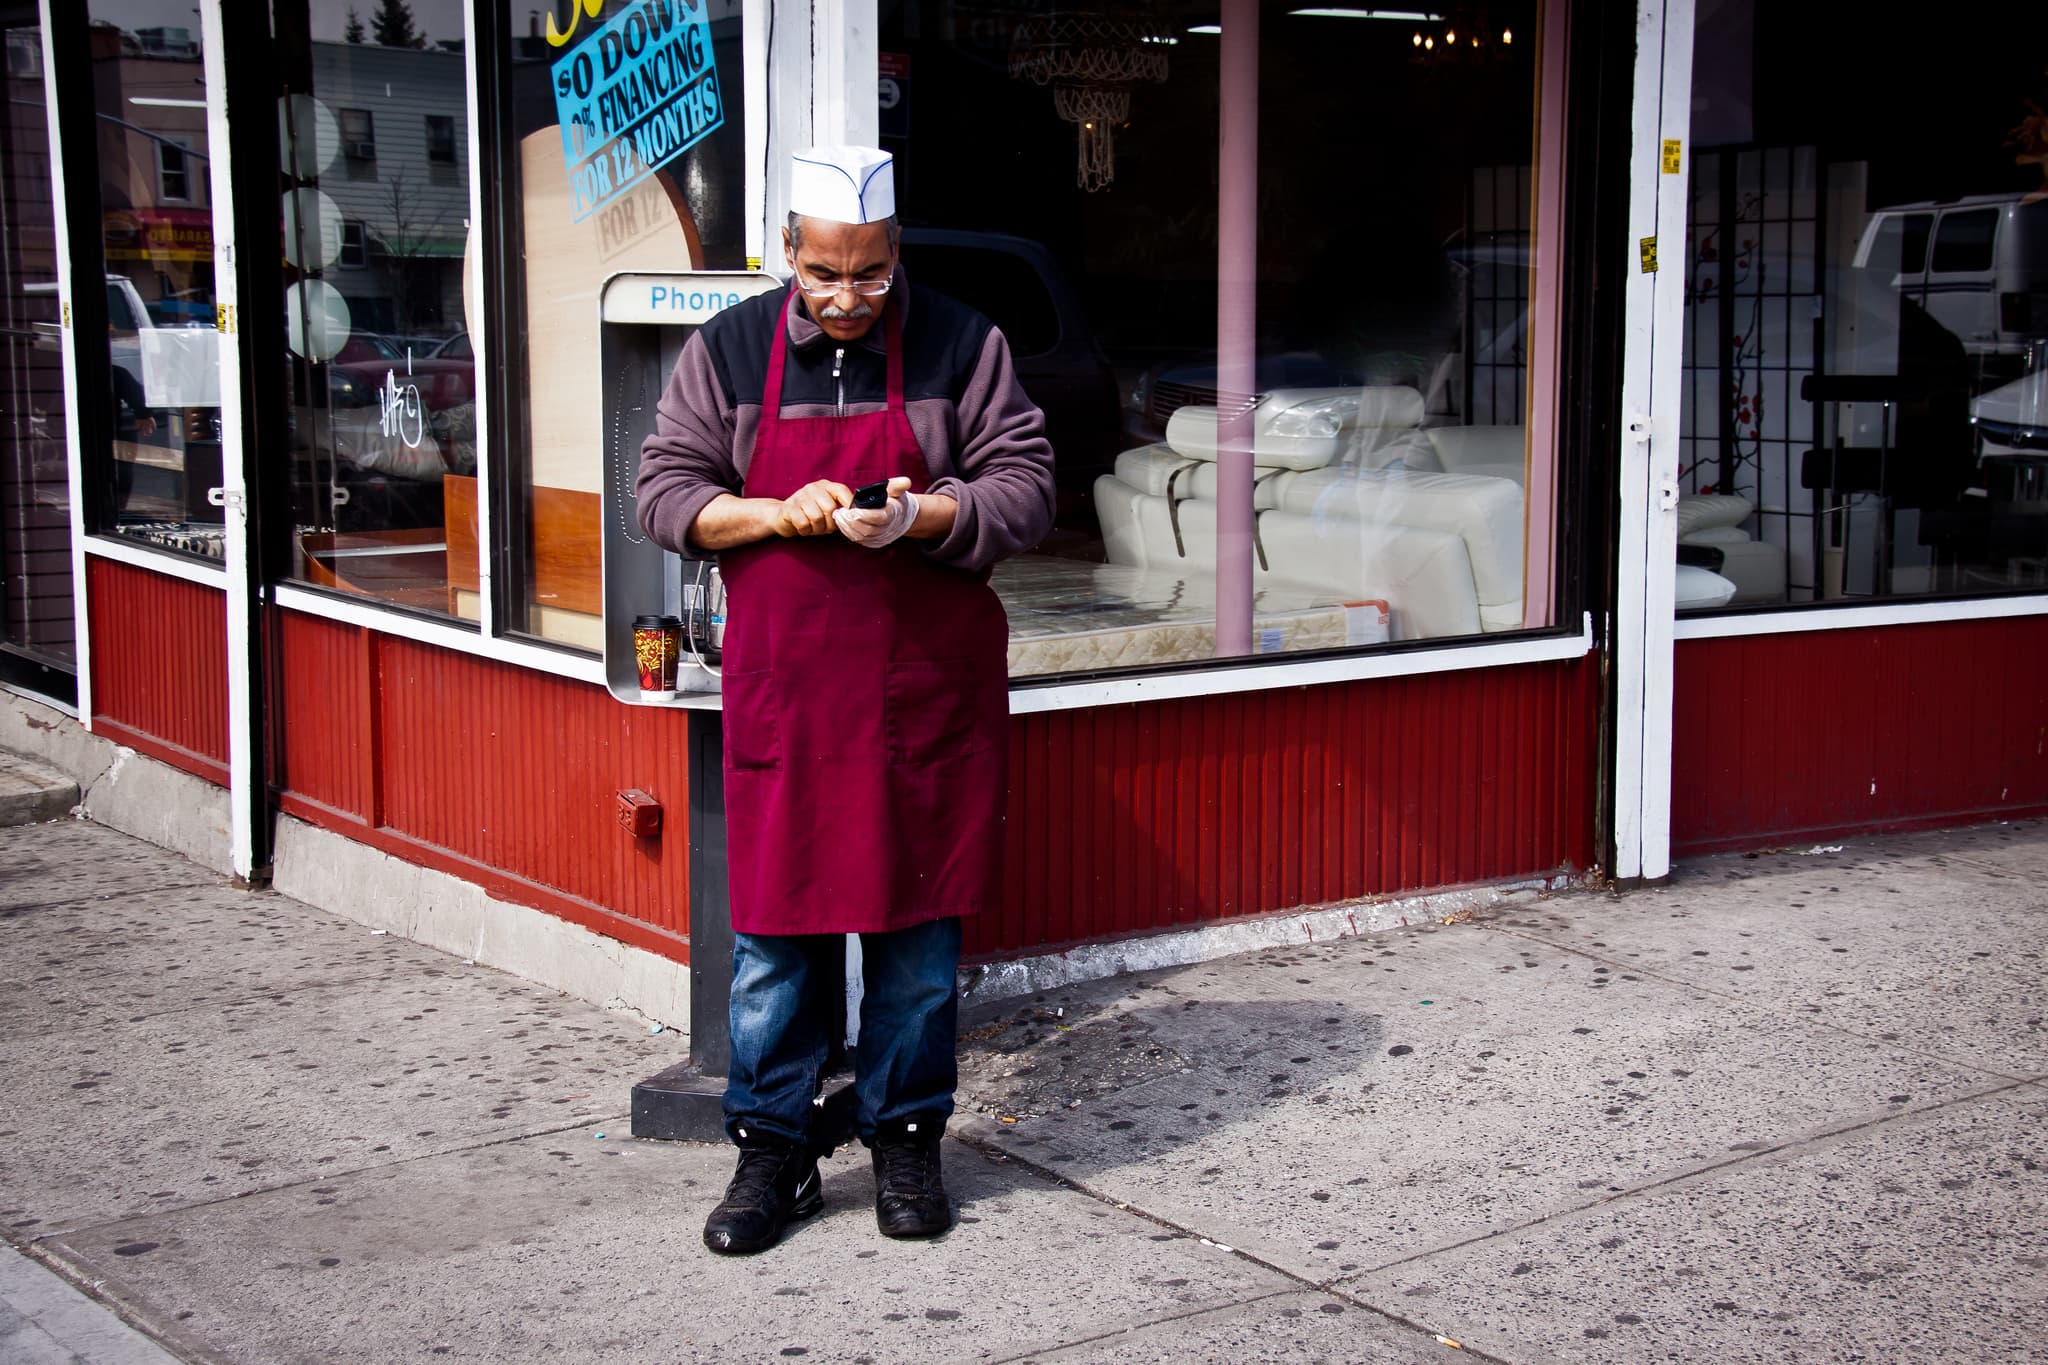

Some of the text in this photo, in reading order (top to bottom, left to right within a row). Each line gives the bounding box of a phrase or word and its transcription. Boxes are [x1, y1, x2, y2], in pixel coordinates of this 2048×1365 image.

[571, 103, 595, 157] 0%
[598, 23, 705, 139] FINANCING
[572, 77, 717, 212] FOR 12 MONTHS
[651, 286, 740, 311] Phone
